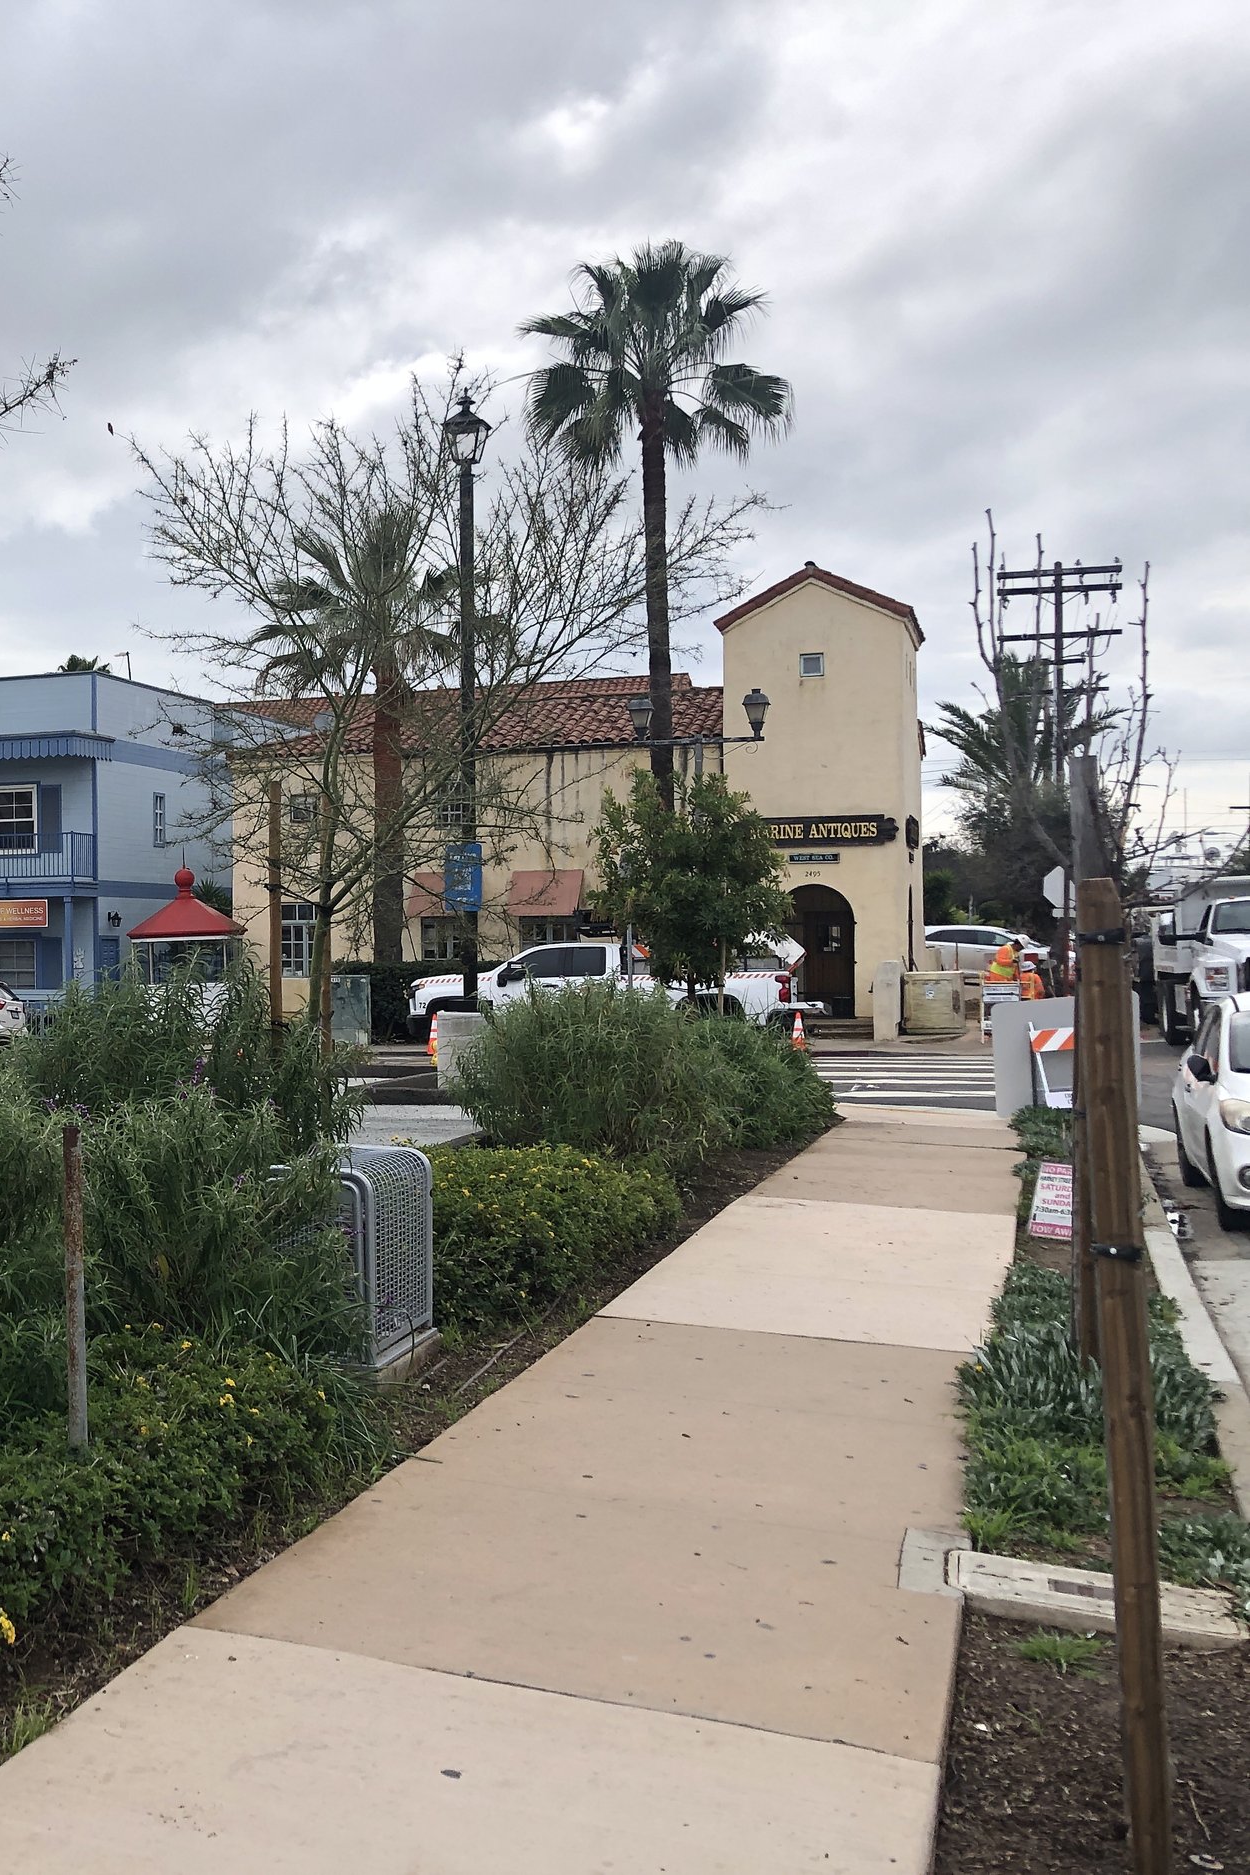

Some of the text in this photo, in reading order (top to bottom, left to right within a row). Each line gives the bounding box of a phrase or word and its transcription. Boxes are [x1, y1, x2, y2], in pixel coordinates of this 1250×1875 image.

[750, 822, 877, 839] RINE ANTIQUES
[6, 906, 44, 914] WELLNESS
[1040, 1183, 1072, 1192] SATURD
[1042, 1199, 1071, 1207] SUNDA
[1032, 1224, 1072, 1237] TOW AW
